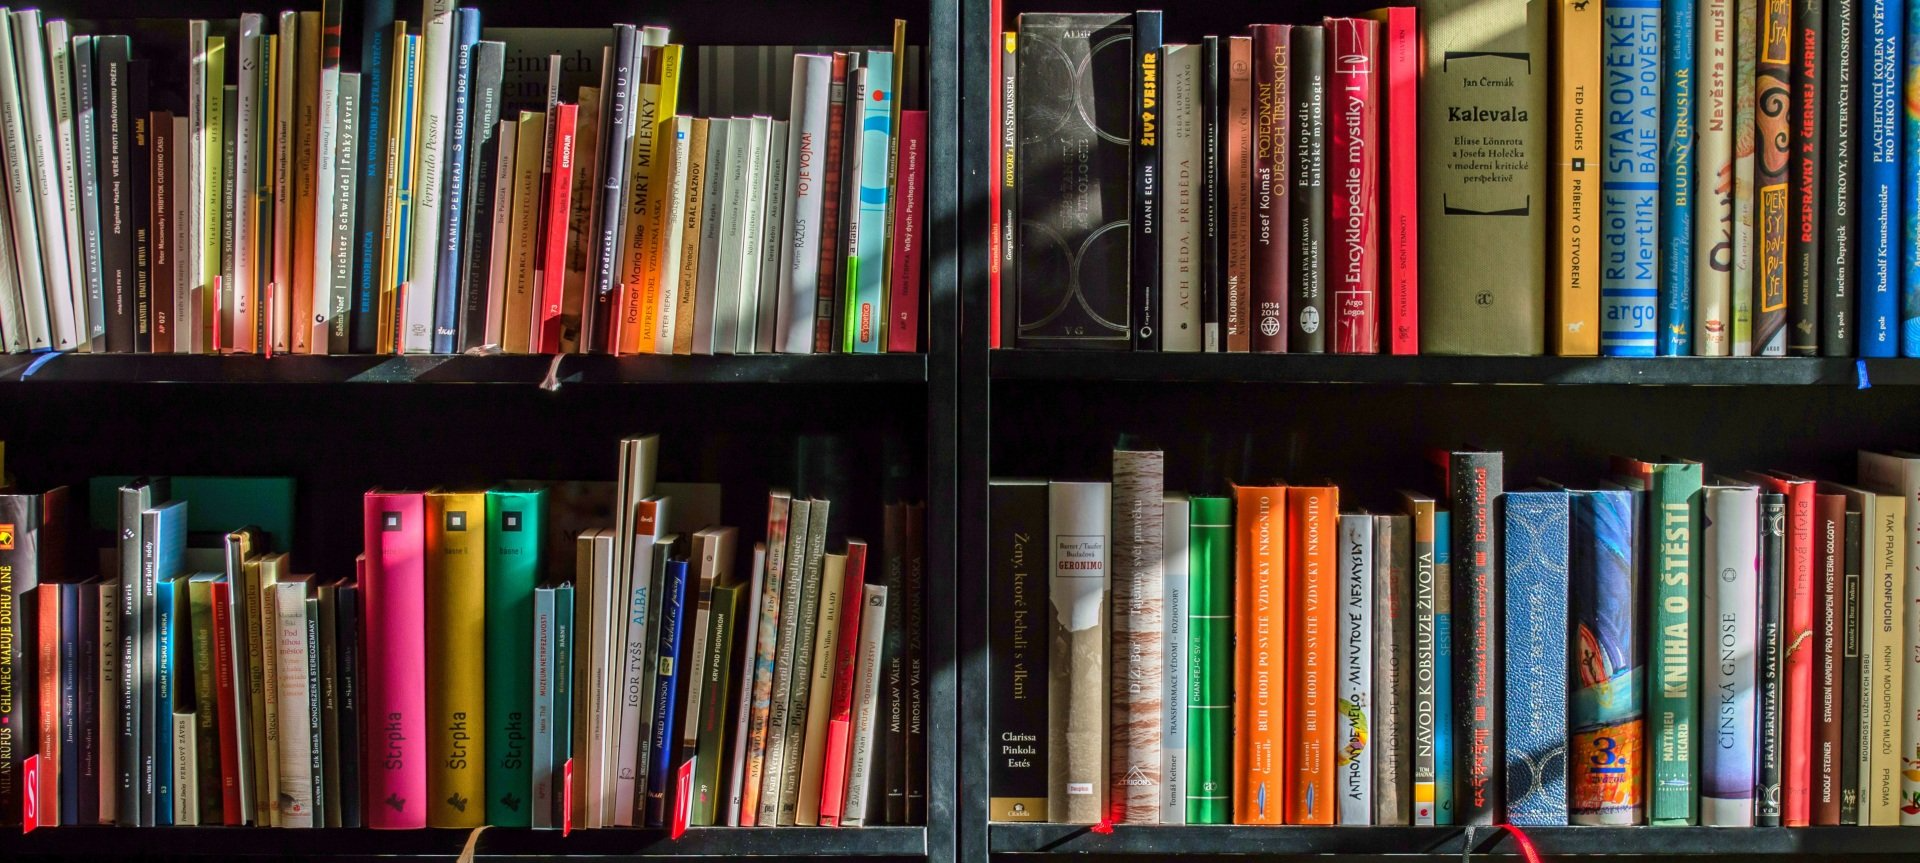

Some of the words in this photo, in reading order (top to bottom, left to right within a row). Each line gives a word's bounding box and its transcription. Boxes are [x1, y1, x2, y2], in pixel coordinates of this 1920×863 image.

[458, 44, 468, 69] teba
[1638, 15, 1657, 96] POVĚSTI
[1802, 28, 1815, 78] AFRIKY
[1884, 37, 1895, 96] TUČŇÁKA
[457, 73, 467, 93] bez
[615, 66, 627, 124] KUBUS
[1142, 53, 1155, 108] VESMÍR
[1463, 77, 1477, 88] Jan
[1479, 76, 1514, 87] Čermák
[1576, 85, 1584, 105] TED
[1606, 15, 1634, 173] STAROVĚKÉ
[110, 89, 118, 133] ZDAŇOVANIU
[455, 107, 464, 140] tebou
[1312, 75, 1322, 137] mytologie
[1448, 107, 1528, 122] Kalevala
[1640, 108, 1656, 119] A
[1801, 84, 1814, 138] ČIERNEJ
[1884, 99, 1895, 136] PÍRKO
[425, 114, 438, 151] Pessoa
[637, 98, 655, 167] MILENKY
[1141, 113, 1155, 146] ŽIVÝ
[1299, 102, 1310, 186] Encyklopedie
[1346, 96, 1363, 163] mystiky
[1454, 137, 1479, 146] Eliase
[1483, 137, 1523, 145] Lönnrota
[1575, 108, 1583, 151] HUGHES
[562, 135, 571, 168] EUROPAIN
[798, 132, 811, 168] VOJNA!
[908, 151, 916, 170] tenký
[1311, 141, 1321, 186] baltské
[1460, 149, 1485, 159] Josefa
[1488, 149, 1524, 157] Holečka
[1640, 129, 1657, 173] BÁJE
[1803, 144, 1813, 152] Z
[1885, 140, 1895, 162] PRO
[113, 181, 121, 203] Machej
[422, 153, 436, 208] Fernando
[450, 162, 460, 211] PETERAJ
[634, 171, 648, 215] SMRŤ
[797, 184, 807, 197] TO
[798, 171, 811, 182] JE
[906, 171, 916, 212] Psychopolis,
[1144, 166, 1152, 195] ELGIN
[1259, 168, 1270, 209] Kolmaš
[1464, 174, 1513, 183] perspektivě
[339, 174, 349, 230] Schwindel
[1573, 179, 1581, 221] PRÍBEHY
[1801, 159, 1813, 242] ROZPRÁVKY
[113, 205, 121, 234] Zbigniew
[448, 217, 458, 250] KAMIL
[634, 225, 644, 249] Rilke
[905, 214, 914, 231] dych:
[1259, 214, 1270, 245] Josef
[1345, 168, 1364, 283] Encyklopedie
[1878, 185, 1888, 256] Krautschneider
[89, 230, 97, 273] MAZANEC
[904, 232, 913, 252] Veľký
[1607, 197, 1625, 280] Rudolf
[1636, 196, 1652, 280] Mertlík
[1836, 226, 1847, 264] Deprijck
[339, 235, 348, 279] leichter
[631, 251, 641, 283] Maria
[1571, 237, 1580, 289] STVORENÍ
[1835, 267, 1845, 297] Lucien
[1877, 259, 1887, 292] Rudolf
[627, 286, 639, 324] Rainer
[663, 289, 671, 312] REPKA
[901, 312, 907, 320] 43
[1608, 303, 1654, 328] argo
[662, 315, 670, 338] PETER
[1014, 533, 1029, 568] Ženy,
[1662, 503, 1688, 586] ŠTĚSTÍ
[1827, 520, 1835, 553] GOLGOTY
[0, 565, 11, 583] INÉ
[1059, 561, 1103, 570] GERONIMO
[1416, 552, 1432, 609] ŽIVOTA
[1826, 556, 1834, 592] MYSTERIA
[632, 587, 647, 626] ALBA
[1014, 574, 1027, 606] ktoré
[1665, 596, 1688, 612] O
[1884, 574, 1892, 632] KONFUCIUS
[0, 593, 11, 624] DÚHU
[1171, 589, 1179, 634] ROZHOVORY
[1824, 594, 1833, 636] POCHOPENÍ
[0, 627, 11, 665] MAĽUJE
[714, 613, 724, 652] FIGOVNÍKOM
[1014, 611, 1027, 649] behali
[1419, 612, 1432, 681] OBSLUZE
[1722, 613, 1736, 676] GNOSE
[1825, 637, 1833, 653] PRO
[627, 642, 642, 672] TYŠŠ
[889, 658, 900, 685] VÁLEK
[910, 659, 921, 686] VÁLEK
[1170, 643, 1179, 673] VĚDOMÍ
[1664, 624, 1688, 697] KNIHA
[1, 667, 11, 713] CHLAPEC
[539, 668, 547, 696] MUZEUM
[628, 677, 639, 707] IGOR
[1014, 661, 1027, 700] vlkmi
[1420, 684, 1431, 695] K
[658, 681, 668, 718] TENNYSON
[890, 688, 900, 732] MIROSLAV
[911, 689, 921, 733] MIROSLAV
[1171, 675, 1179, 735] TRANSFORMACE
[1718, 682, 1735, 749] ČÍNSKÁ
[1824, 687, 1832, 722] STAVEBNÍ
[125, 711, 133, 736] James
[178, 720, 186, 744] ZÁVES
[385, 713, 406, 770] Štrpka
[446, 712, 470, 769] Štrpka
[501, 712, 525, 769] Štrpka
[656, 721, 664, 748] ALFRED
[1002, 732, 1036, 742] Clarissa
[1418, 699, 1432, 757] NÁVOD
[1663, 712, 1674, 762] MATTHIEU
[769, 733, 781, 774] Wernisch
[1002, 745, 1036, 755] Pinkola
[1591, 737, 1626, 765] 3.
[1678, 724, 1688, 761] RICARD
[179, 746, 187, 780] PERLOVÝ
[1008, 758, 1030, 768] Estés
[1170, 755, 1178, 782] Keltner
[700, 784, 708, 792] 39
[767, 777, 777, 795] Ivan
[1823, 775, 1831, 803] RUDOLF
